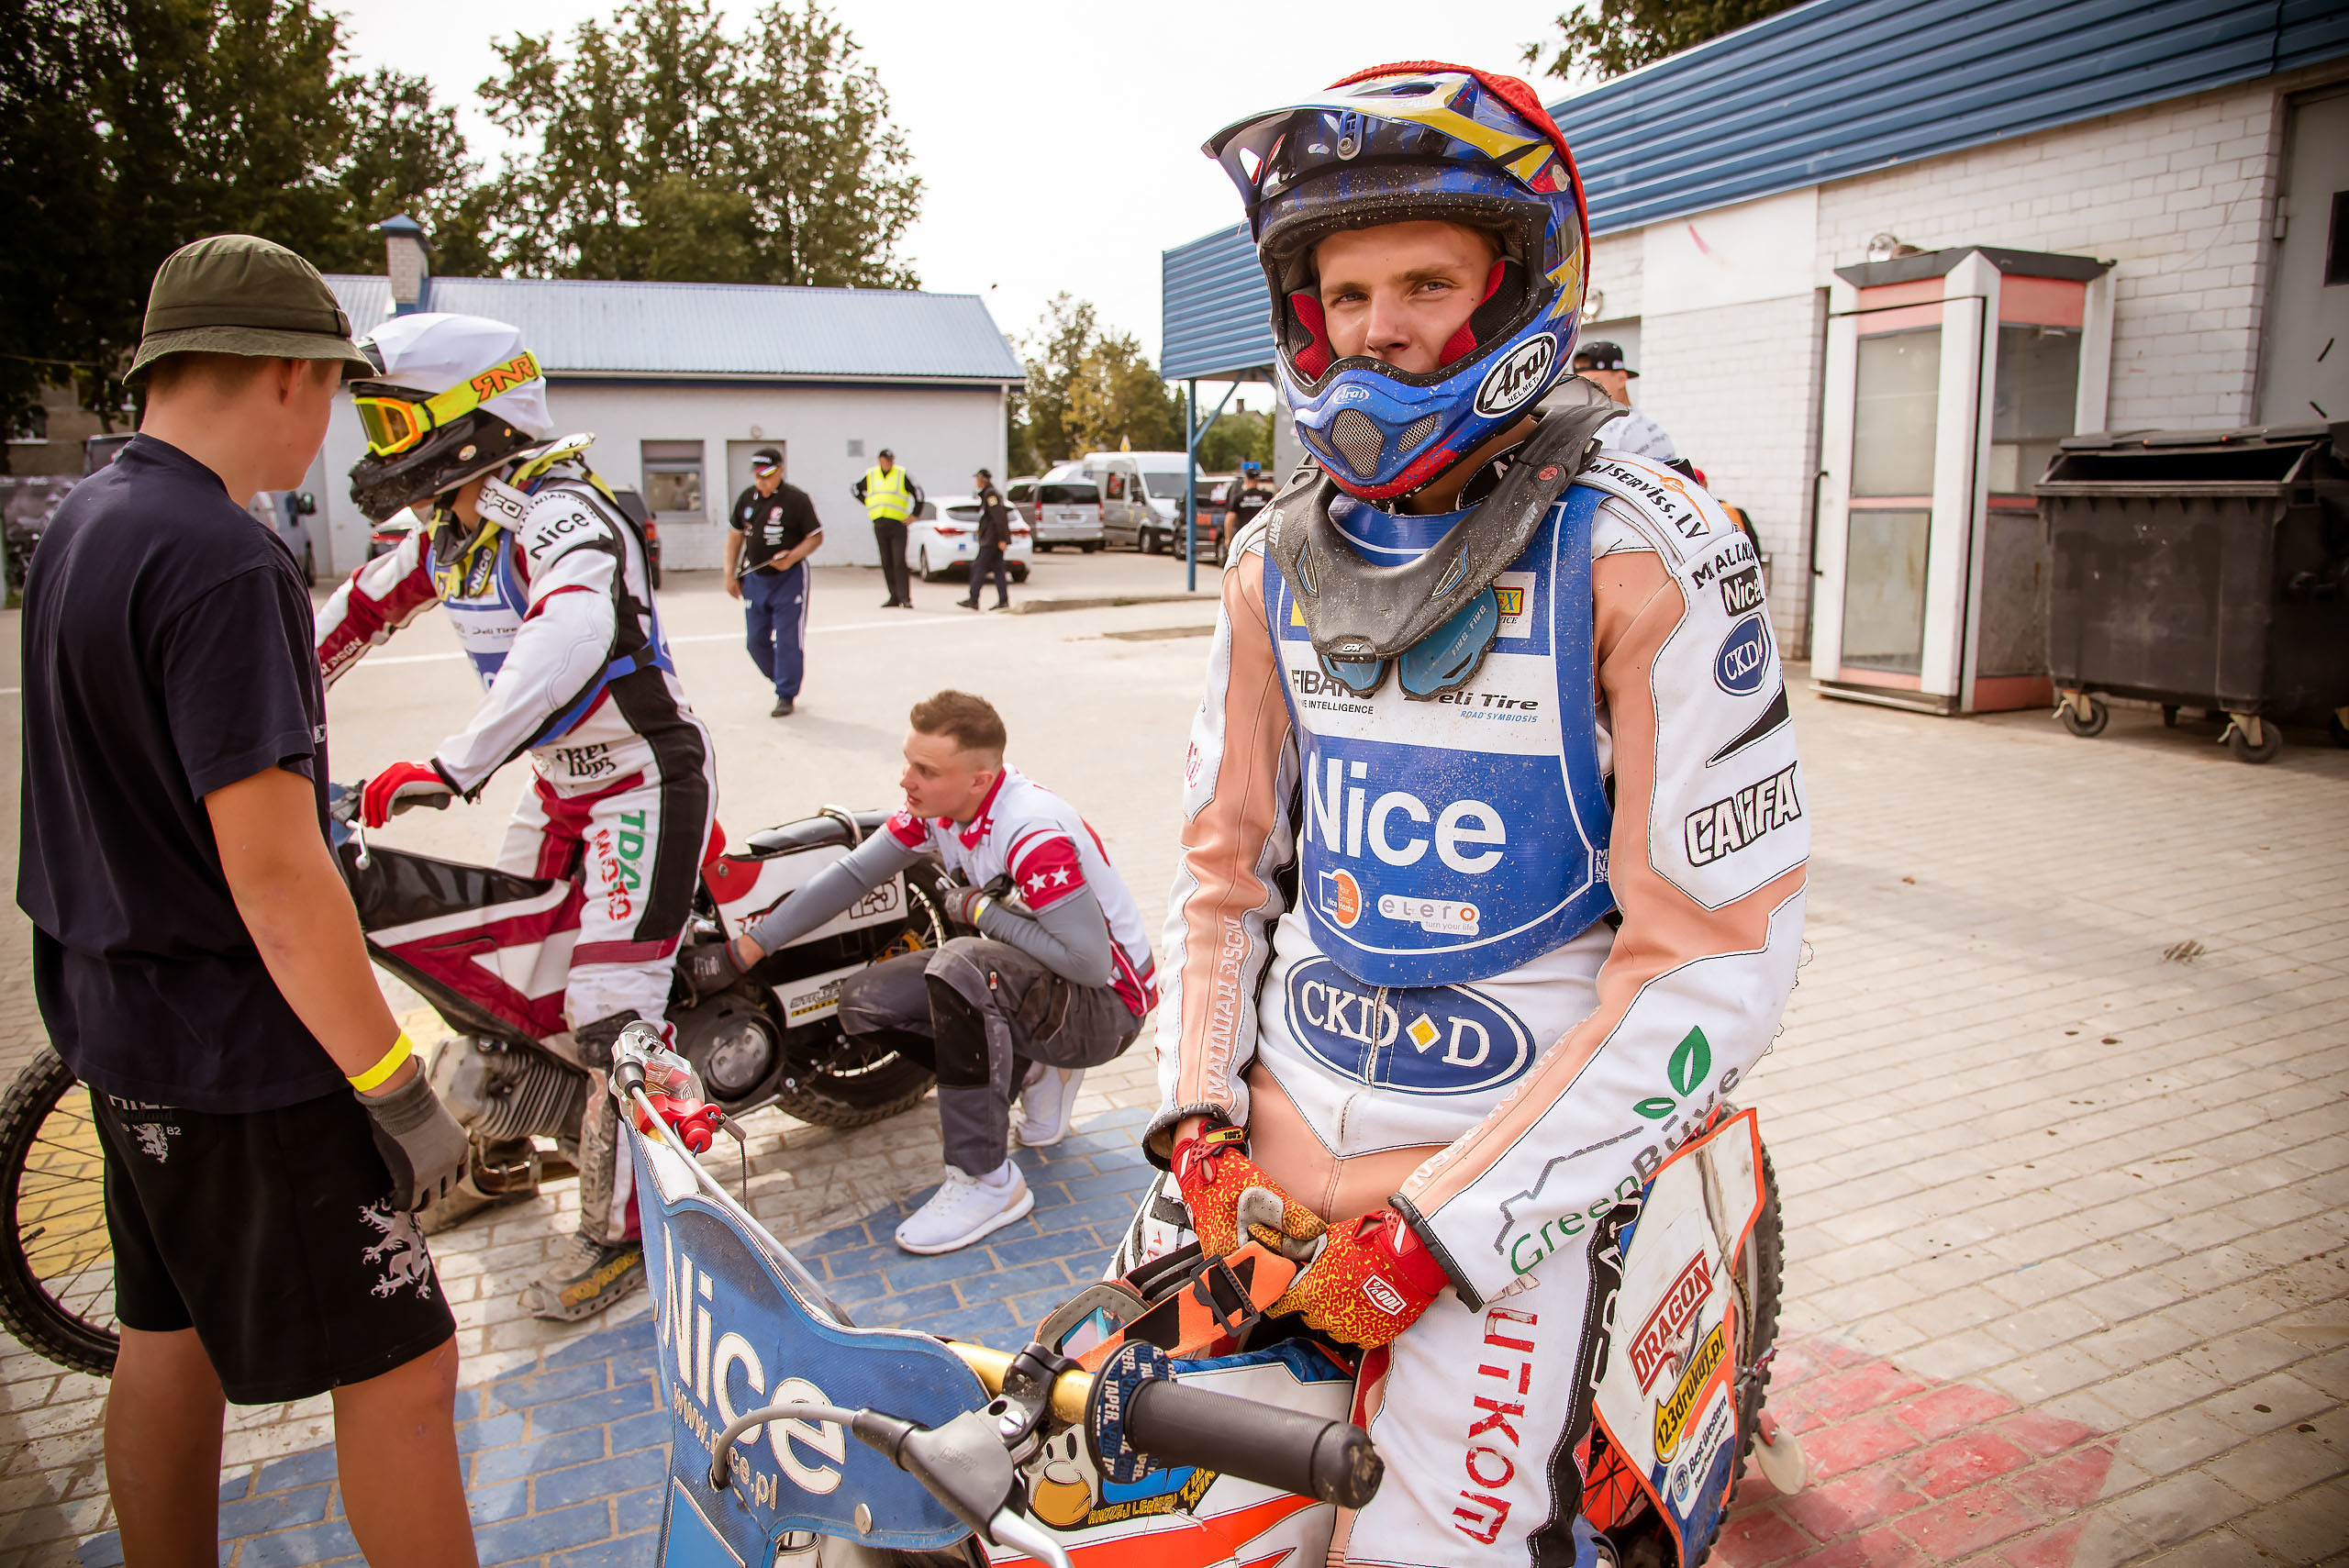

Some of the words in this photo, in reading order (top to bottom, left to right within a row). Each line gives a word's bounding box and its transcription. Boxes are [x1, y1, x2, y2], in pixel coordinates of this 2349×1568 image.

[1483, 338, 1549, 412] Arai
[1508, 377, 1540, 405] HELMET
[530, 513, 589, 561] Nice
[1722, 577, 1761, 612] Nice
[1451, 633, 1468, 656] FIVE
[1469, 604, 1486, 630] FIVE
[1308, 700, 1375, 715] INTELLIGENCE
[1461, 709, 1485, 720] ROAD
[1486, 712, 1539, 723] SYMBIOSIS
[1481, 693, 1539, 711] Tire
[1306, 750, 1508, 875] Nice
[613, 810, 646, 890] TDA
[1338, 902, 1355, 914] Home
[1426, 920, 1441, 929] turn
[1442, 923, 1461, 932] your
[1463, 923, 1475, 931] life
[1367, 1281, 1401, 1310] 100%
[1631, 1256, 1710, 1387] DRAGON
[663, 1221, 846, 1496] Nice
[1657, 1329, 1725, 1450] 123drukuj.pl
[673, 1382, 778, 1511] www.nce.pl
